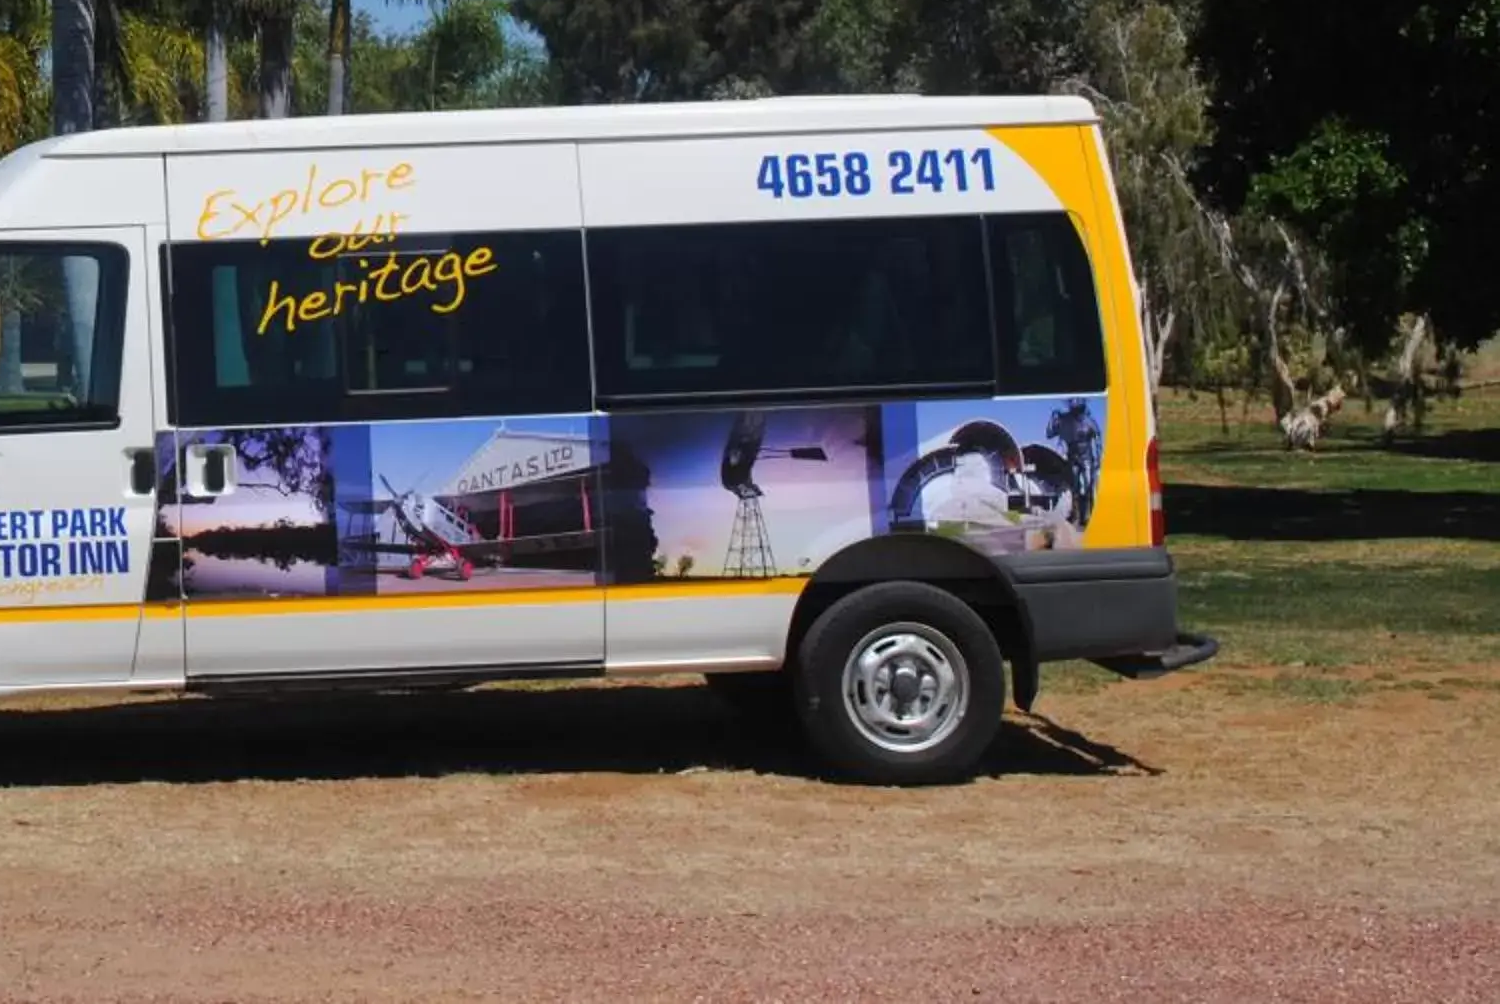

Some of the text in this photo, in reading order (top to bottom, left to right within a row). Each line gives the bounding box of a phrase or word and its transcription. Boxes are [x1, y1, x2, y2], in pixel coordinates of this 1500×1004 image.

[757, 147, 995, 198] 4658 2411
[197, 162, 416, 246] Explore
[308, 210, 409, 259] our
[257, 247, 498, 335] heritage
[52, 507, 127, 538] PARK
[69, 540, 130, 575] INN
